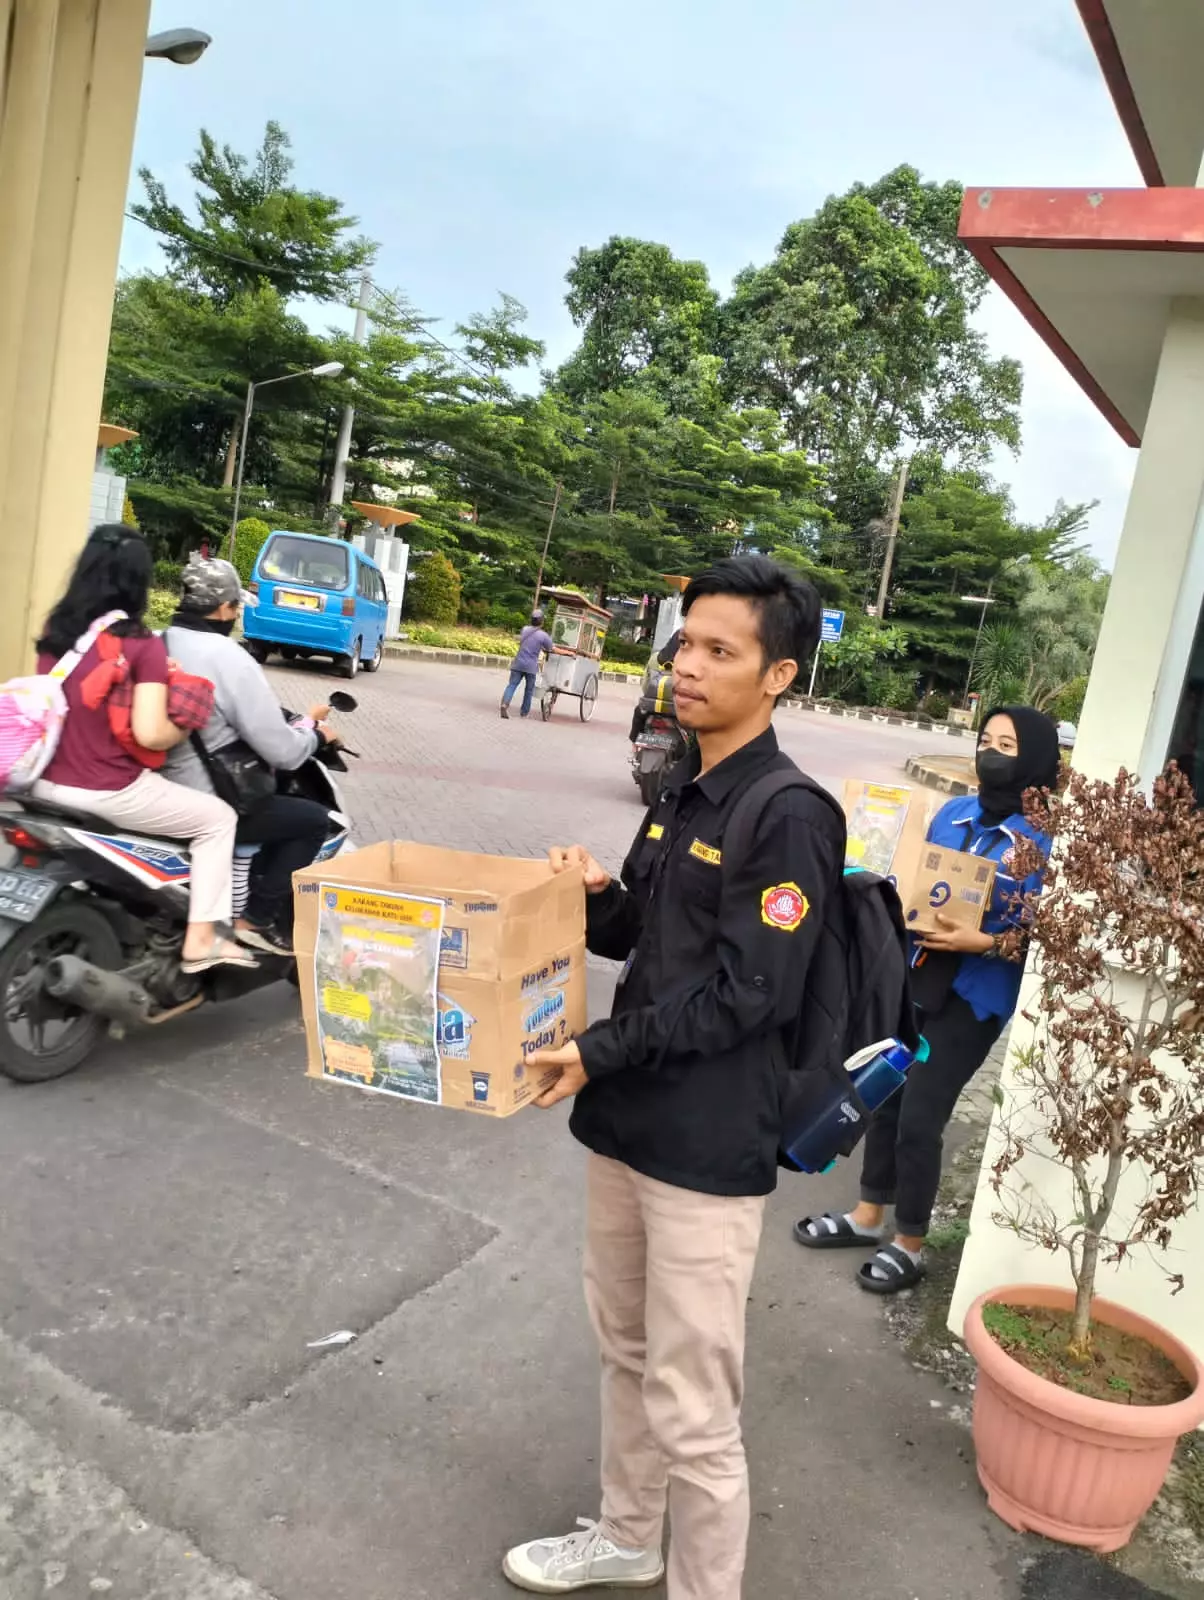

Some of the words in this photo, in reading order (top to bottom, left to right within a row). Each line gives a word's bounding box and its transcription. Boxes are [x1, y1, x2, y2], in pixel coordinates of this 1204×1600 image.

[521, 968, 548, 990] Have
[552, 956, 570, 972] You
[521, 1027, 556, 1056] Today
